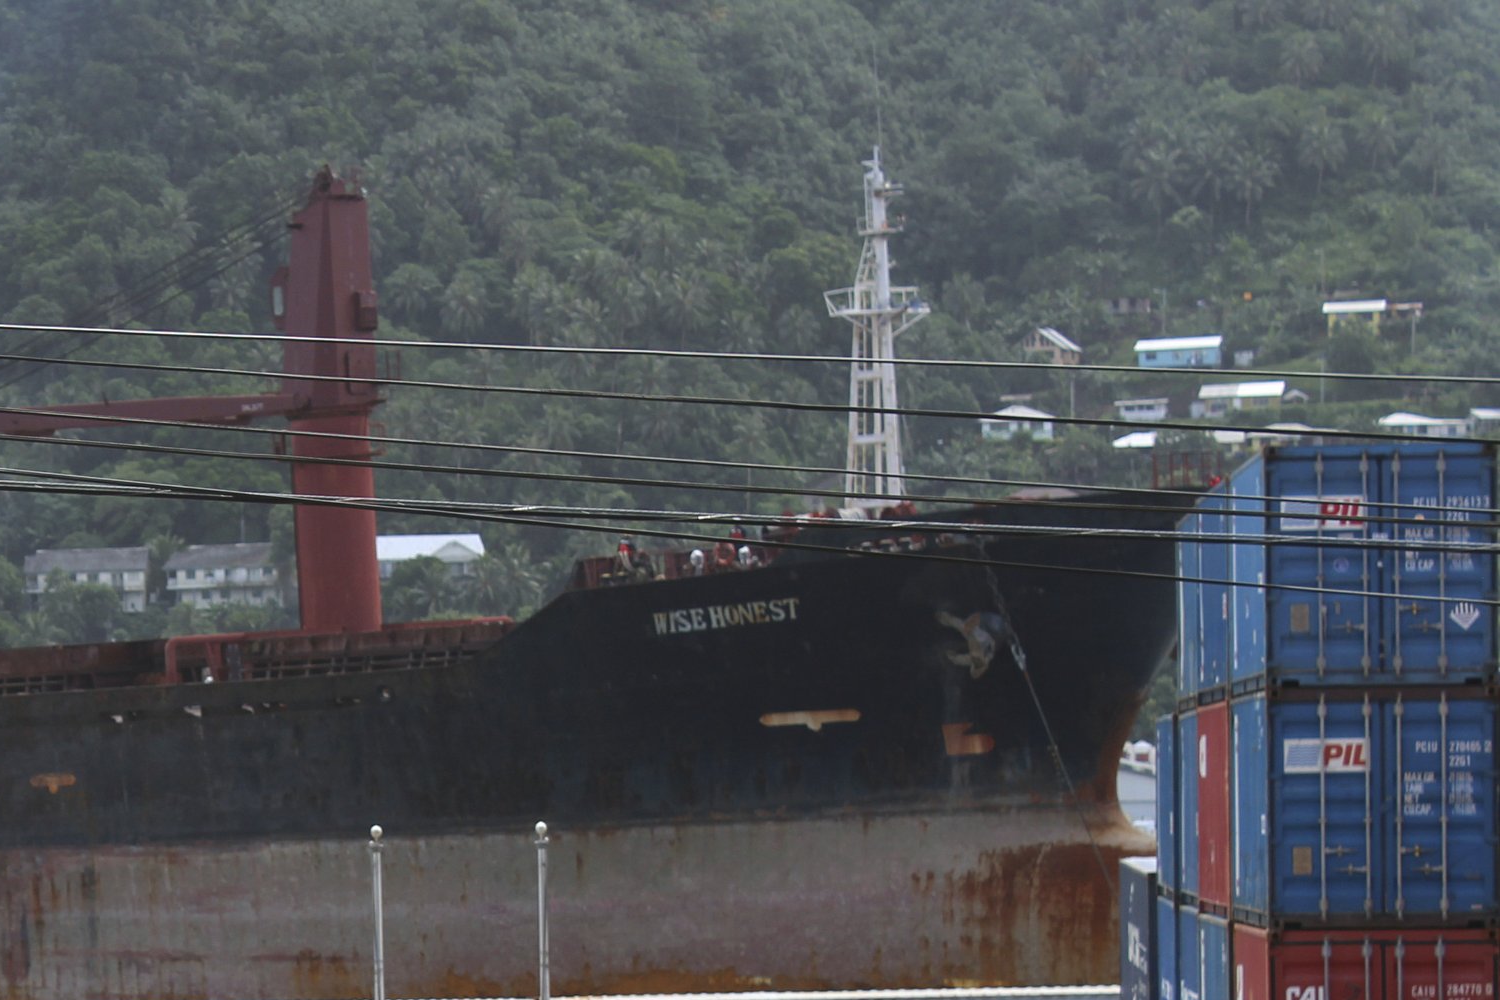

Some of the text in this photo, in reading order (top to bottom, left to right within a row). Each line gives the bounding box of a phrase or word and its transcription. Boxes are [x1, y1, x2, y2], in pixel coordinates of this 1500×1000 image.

[1321, 499, 1364, 525] PIL
[653, 598, 799, 635] WISE HONEST
[1323, 744, 1366, 767] PIL
[1415, 741, 1438, 753] PCIU
[1411, 984, 1436, 998] CAIU
[1447, 983, 1482, 997] 284770
